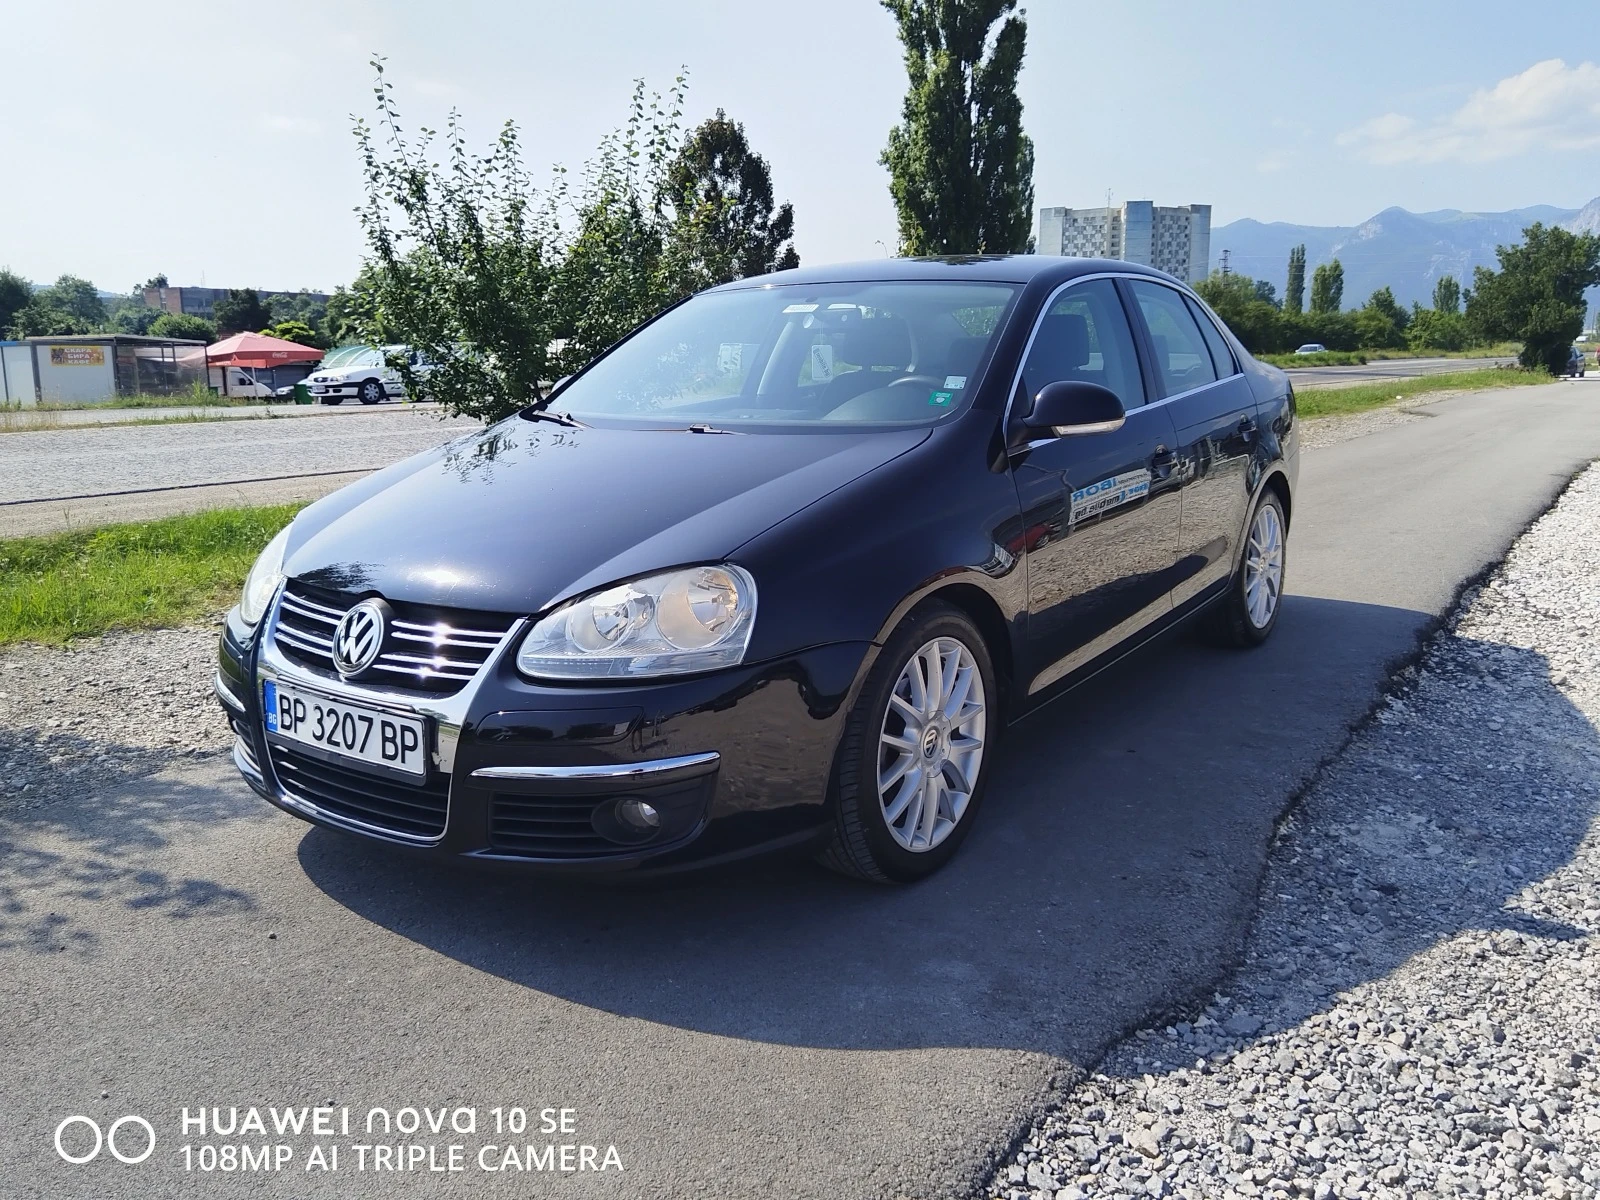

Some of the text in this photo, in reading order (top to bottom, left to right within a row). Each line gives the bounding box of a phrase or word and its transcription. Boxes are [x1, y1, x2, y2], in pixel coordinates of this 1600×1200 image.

[268, 712, 277, 725] BG
[279, 693, 419, 764] BP 3207 BP
